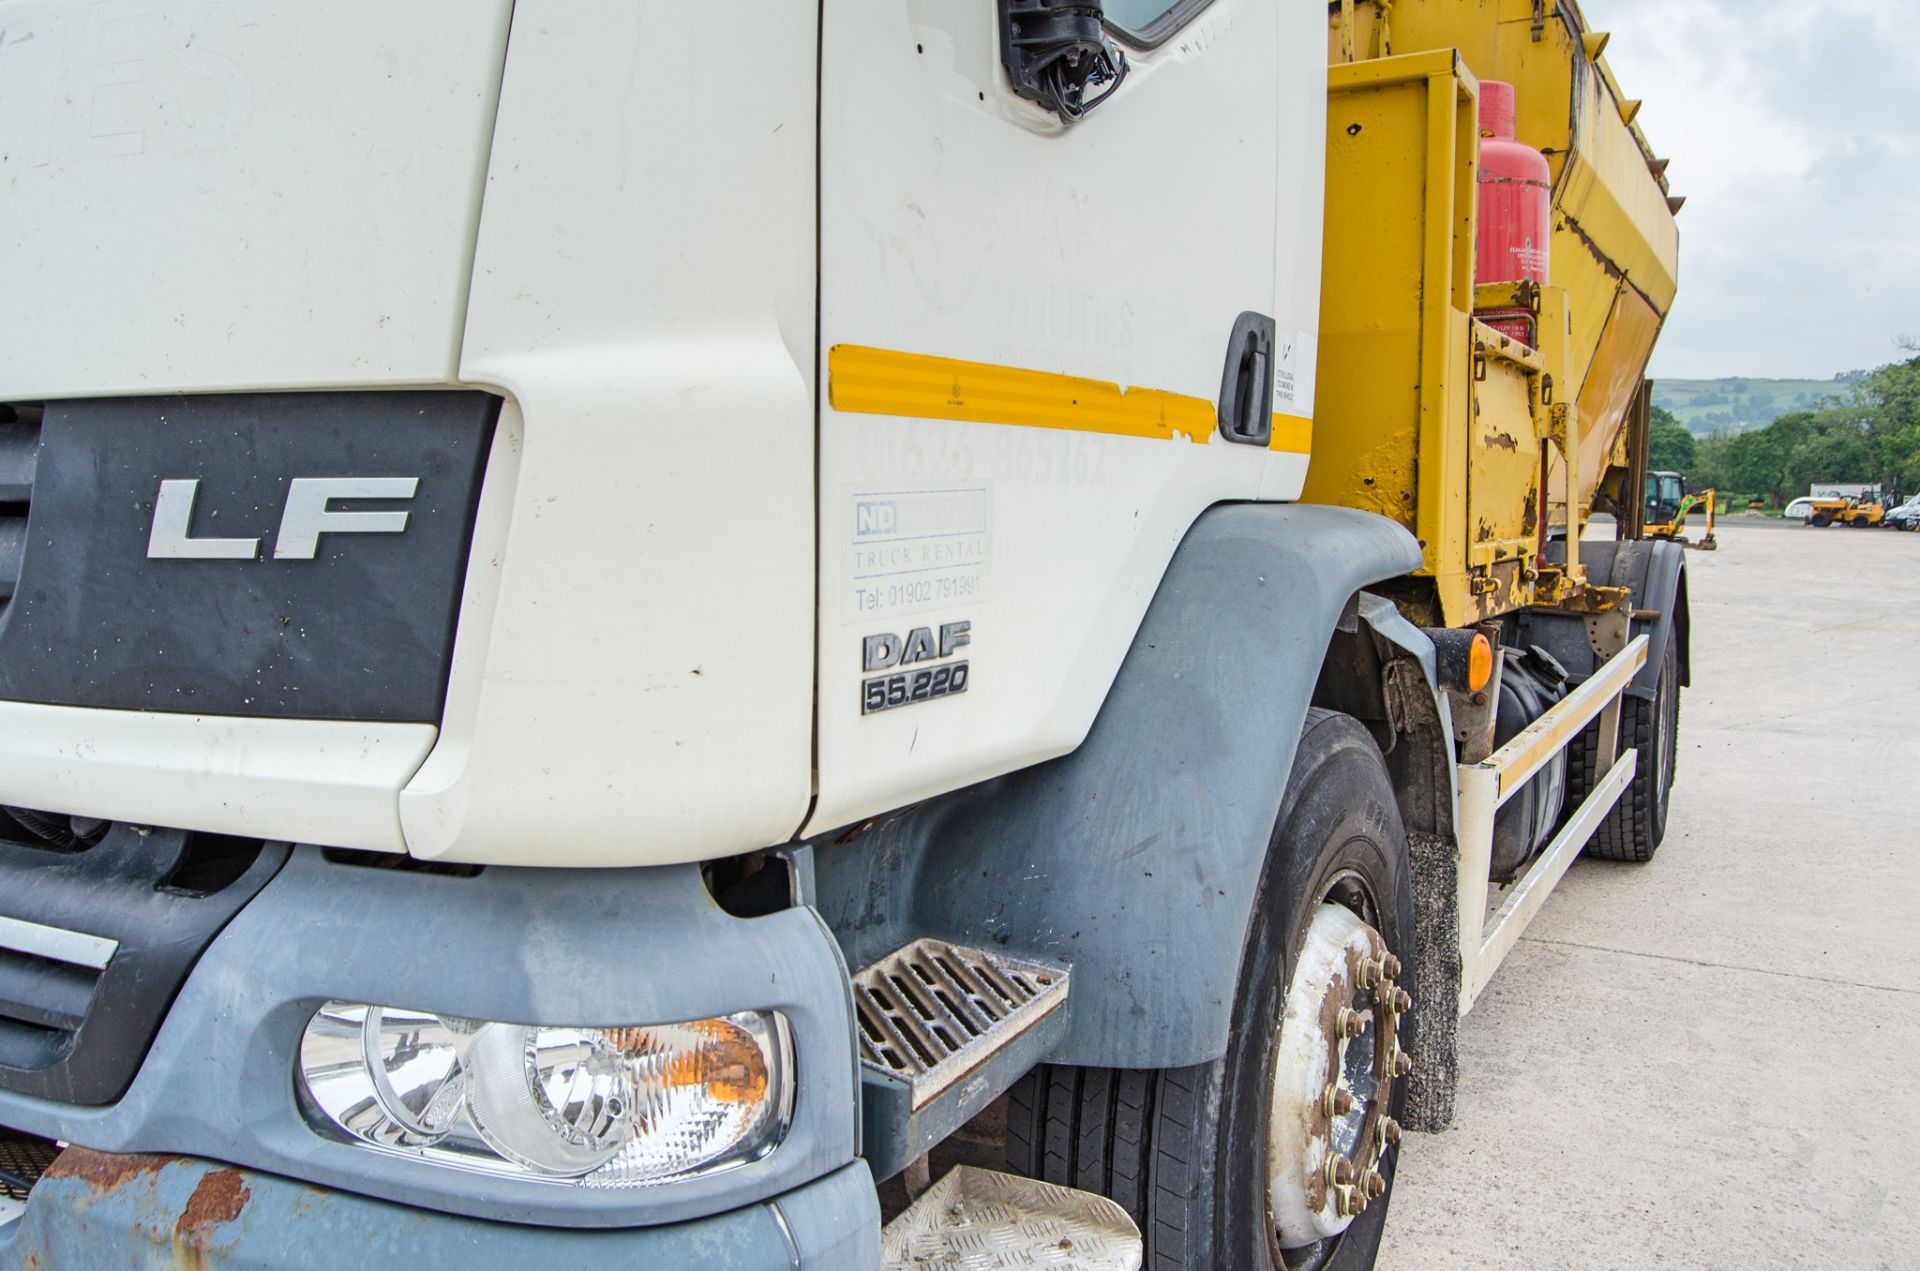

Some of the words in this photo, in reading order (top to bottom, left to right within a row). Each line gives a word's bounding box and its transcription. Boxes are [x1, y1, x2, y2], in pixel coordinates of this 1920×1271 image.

[147, 477, 420, 560] LF
[857, 502, 896, 535] ND
[854, 547, 912, 569] TRUCK
[922, 540, 984, 561] RENTAL
[856, 587, 883, 611] Tel:
[888, 580, 931, 606] 01902
[862, 620, 971, 672] DAF
[864, 662, 969, 712] 55.220
